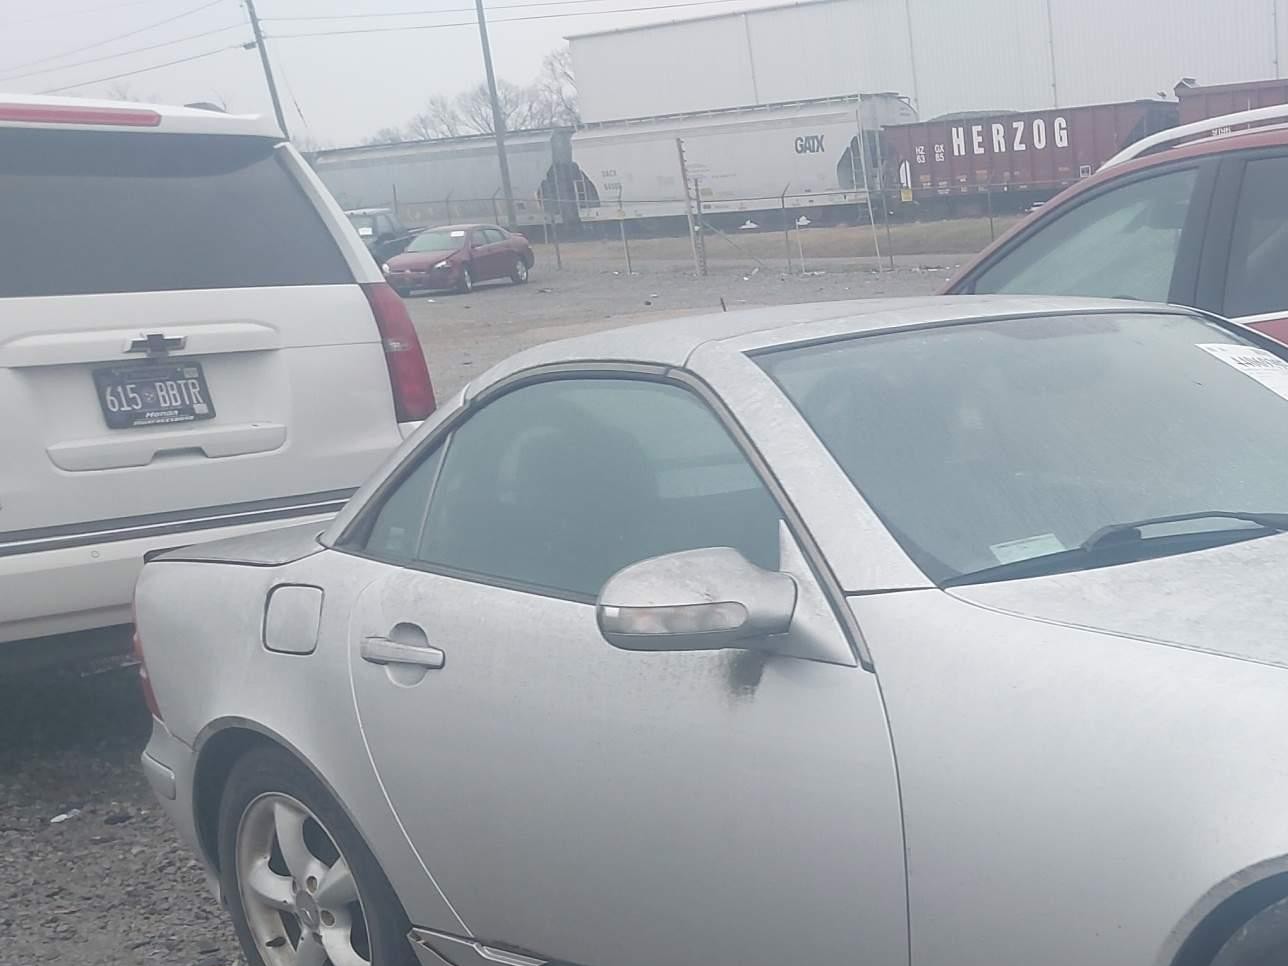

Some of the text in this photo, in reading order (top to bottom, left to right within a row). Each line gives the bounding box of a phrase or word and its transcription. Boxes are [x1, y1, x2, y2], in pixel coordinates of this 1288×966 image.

[794, 134, 825, 154] GATX
[951, 117, 1069, 156] HERZOG
[105, 379, 204, 412] 615 BBTR
